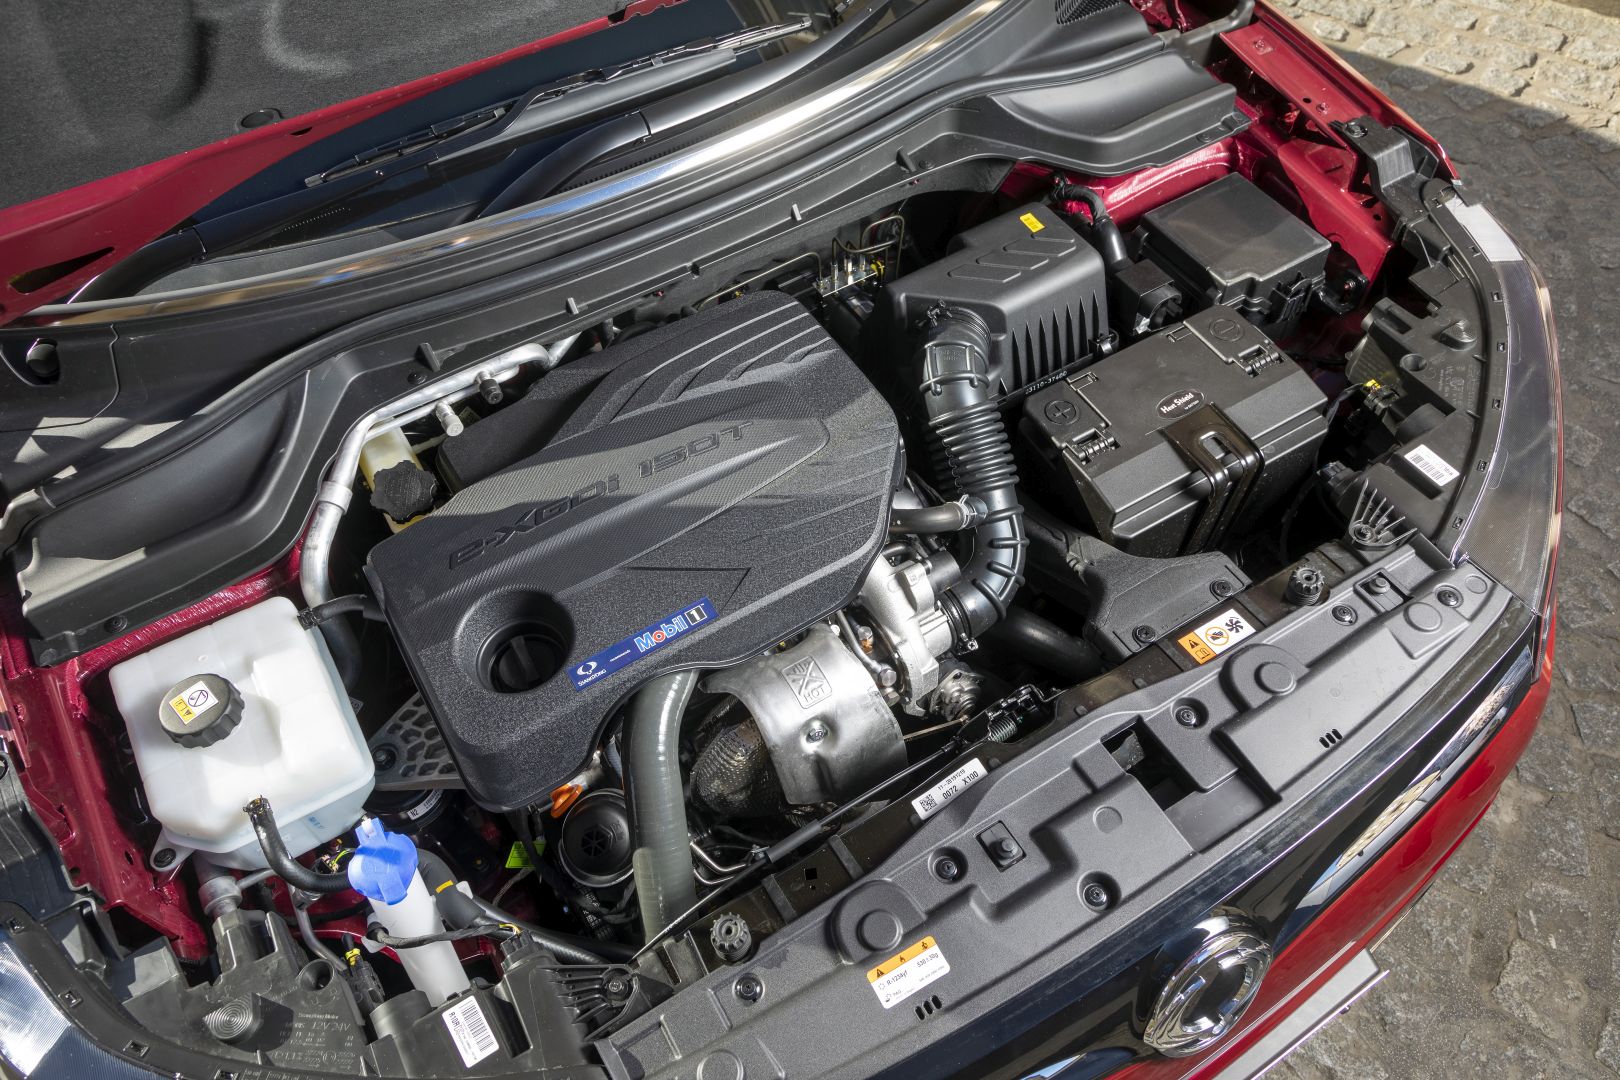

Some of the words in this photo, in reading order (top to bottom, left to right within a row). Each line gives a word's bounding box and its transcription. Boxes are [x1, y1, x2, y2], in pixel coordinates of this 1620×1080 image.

[1160, 403, 1177, 414] Heat
[1174, 392, 1194, 406] Shield
[639, 421, 753, 478] 150T
[633, 614, 689, 653] Mobil
[942, 785, 959, 800] 0072
[962, 770, 979, 786] X100
